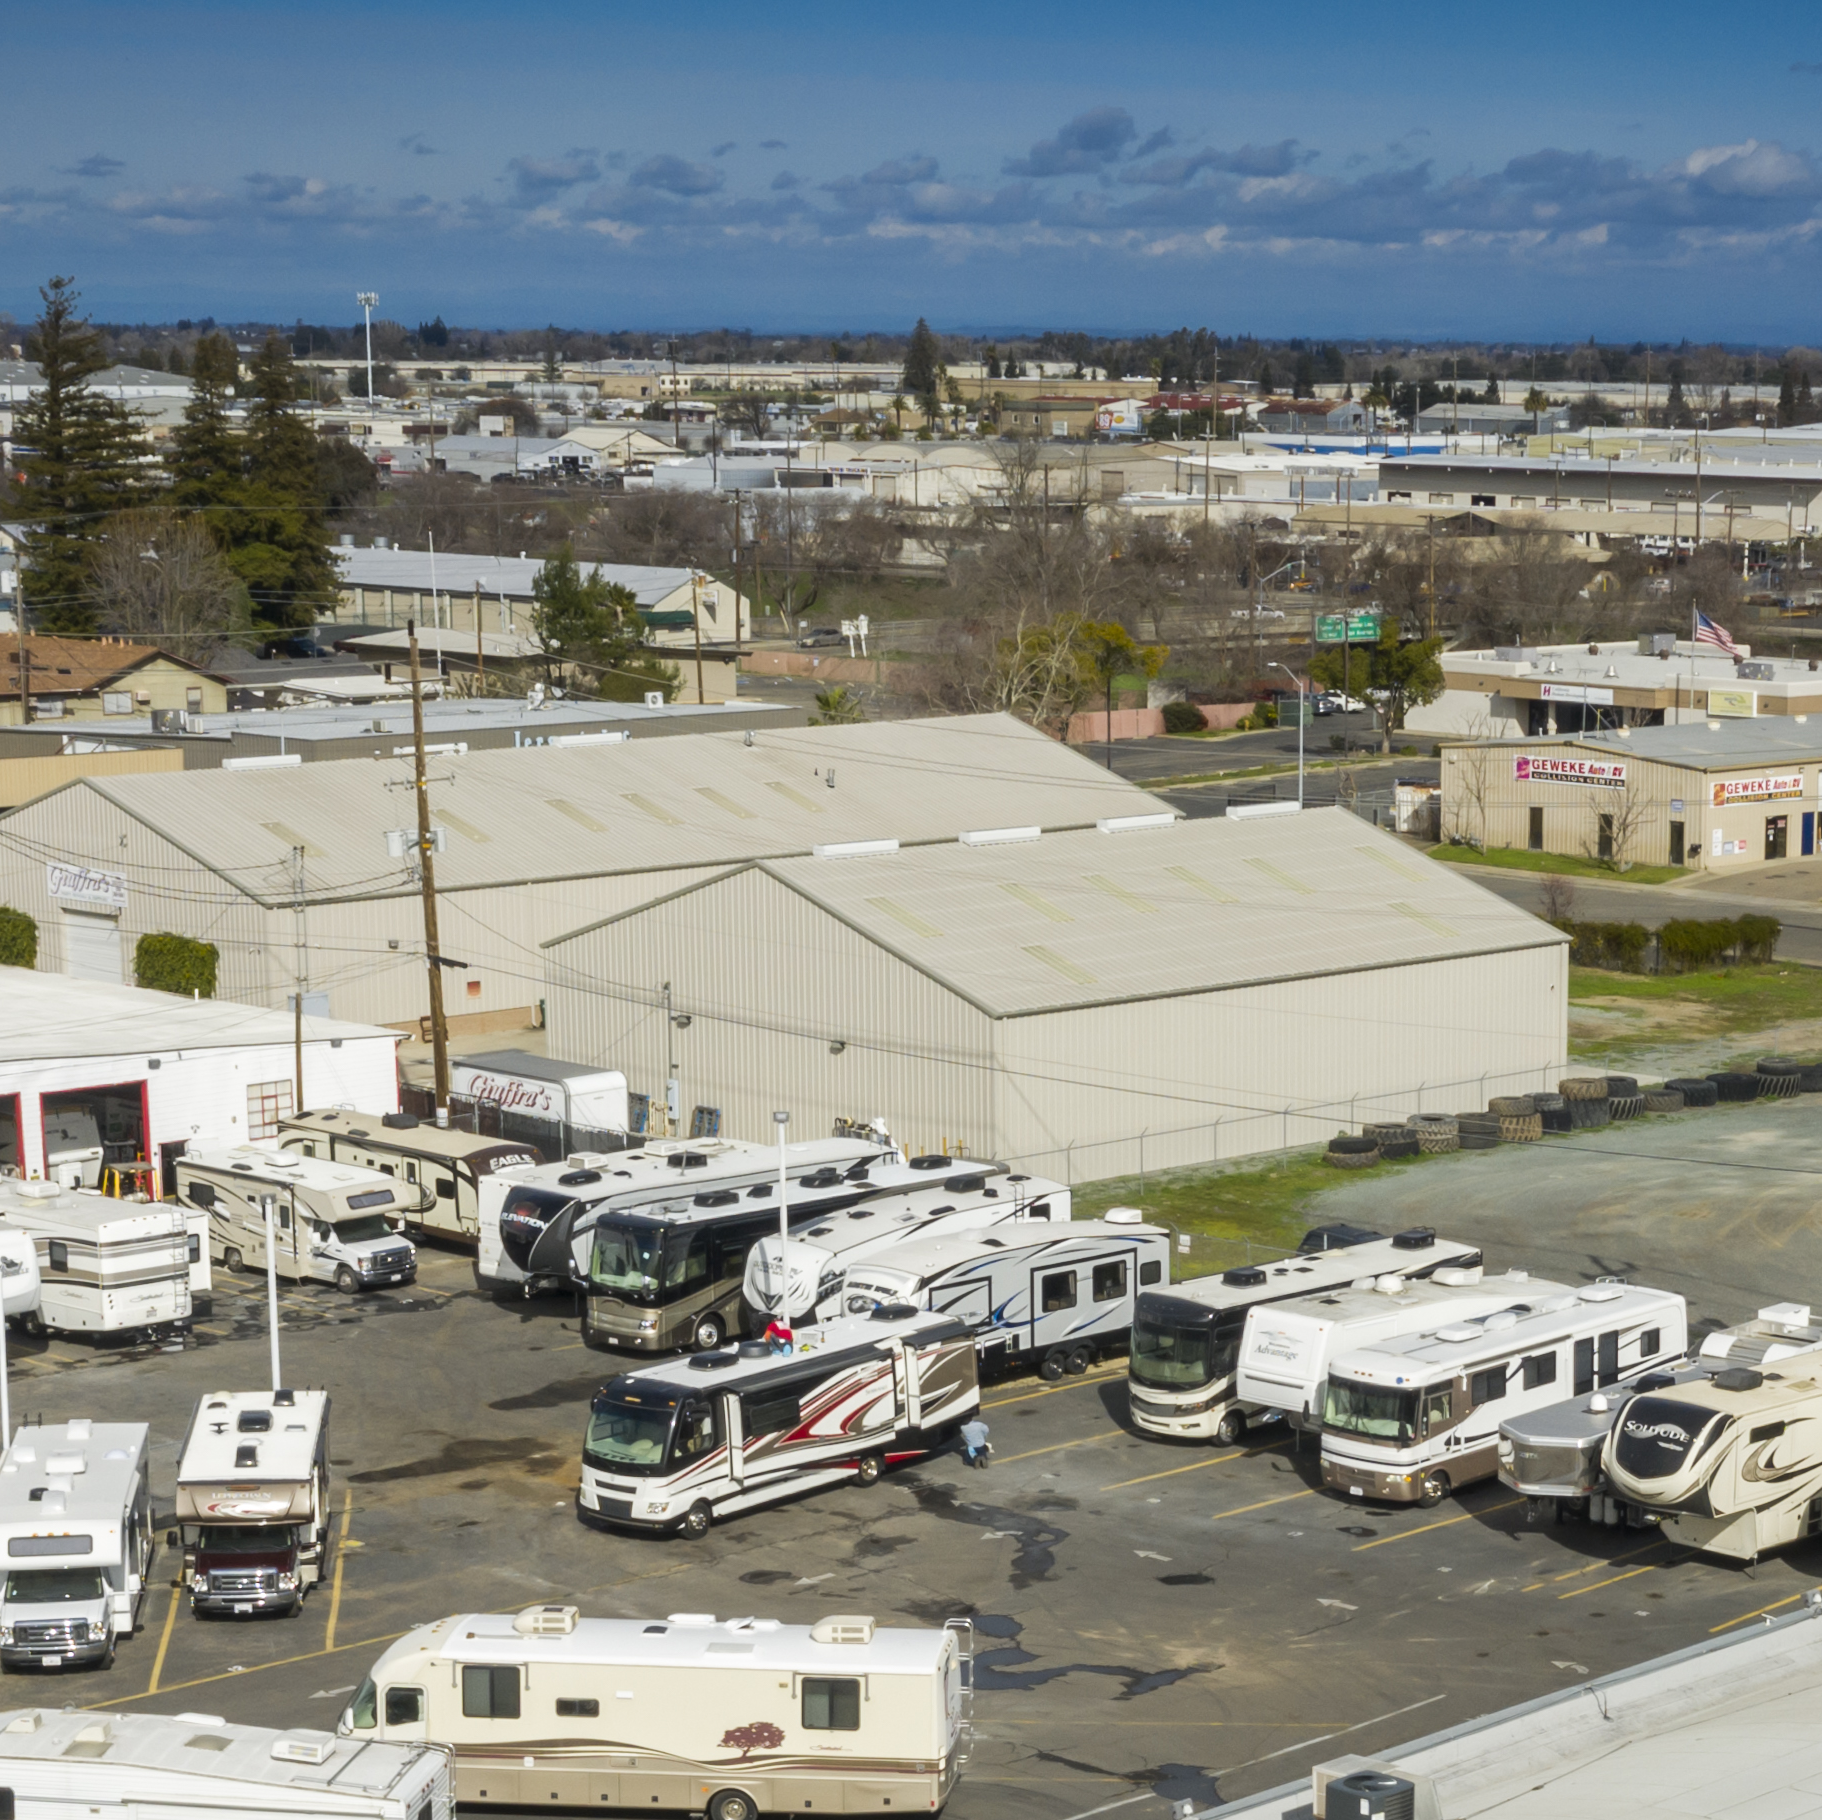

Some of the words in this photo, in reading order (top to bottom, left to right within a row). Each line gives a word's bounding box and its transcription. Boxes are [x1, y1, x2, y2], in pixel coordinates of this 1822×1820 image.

[1532, 759, 1585, 774] GEWEKE
[1588, 764, 1606, 777] Auto
[1612, 766, 1624, 778] RV
[1533, 772, 1584, 783] COLLISION
[1586, 775, 1624, 787] CENTER
[1726, 779, 1771, 794] GEWEKE
[1773, 779, 1788, 790] Auto
[1792, 777, 1802, 788] RV
[1727, 792, 1769, 803] COLLISION
[1772, 790, 1801, 800] CENTER
[469, 1074, 552, 1111] Giuffra's
[489, 1154, 536, 1169] EAGLE
[1624, 1420, 1691, 1443] SOLITUDE
